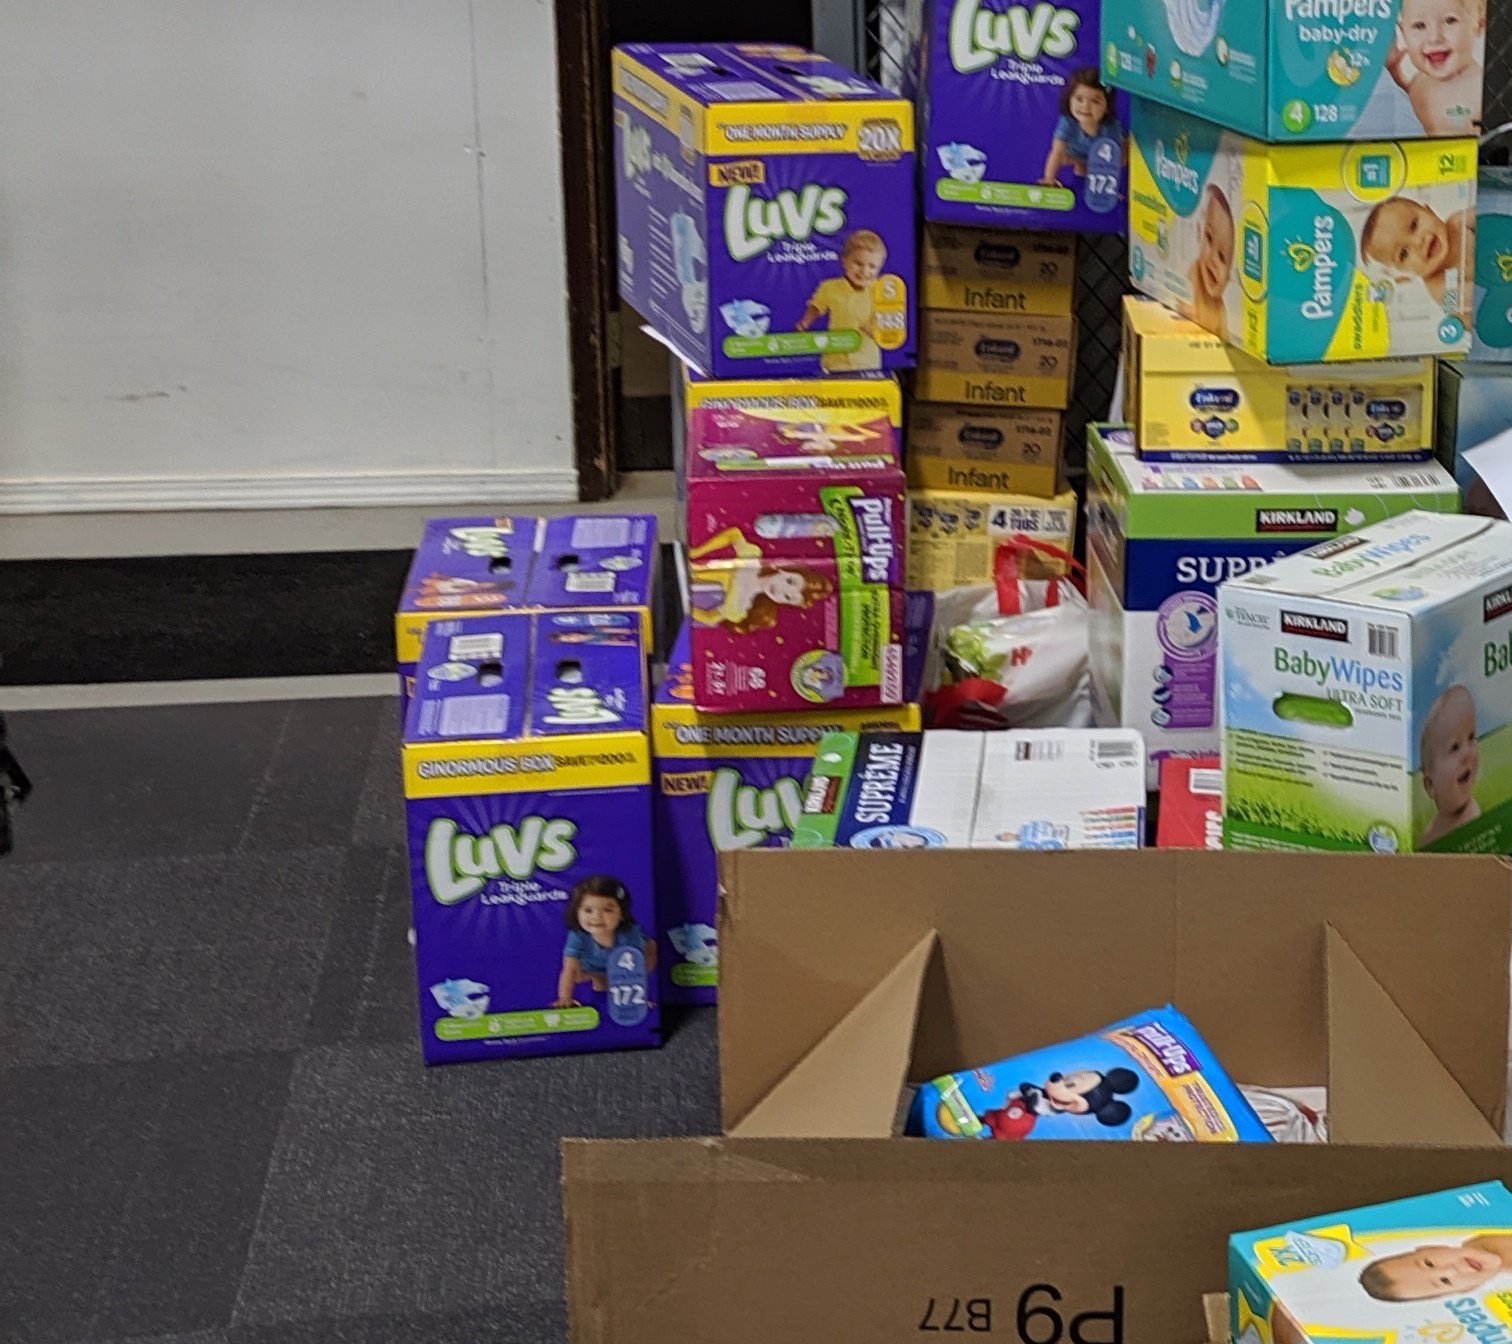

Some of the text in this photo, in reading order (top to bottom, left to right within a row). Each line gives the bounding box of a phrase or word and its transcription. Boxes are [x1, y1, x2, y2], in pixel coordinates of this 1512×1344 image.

[1298, 24, 1378, 44] baby-dry
[1289, 105, 1338, 123] 4 128
[1155, 141, 1199, 195] Pampers
[1089, 173, 1118, 194] 172
[725, 183, 848, 262] Luvs
[1301, 215, 1335, 320] Pampers
[964, 286, 1027, 310] Infant
[965, 380, 1027, 403] Infant
[948, 466, 1010, 489] Infant
[1259, 511, 1337, 524] KIRKLAND
[849, 497, 890, 582] Pull-Ups
[1283, 613, 1347, 634] KIRKLAND
[1274, 646, 1404, 692] BabyWipes
[1369, 696, 1403, 712] SOFT
[675, 725, 773, 744] ONE MONTH
[519, 753, 555, 771] BOX
[426, 816, 578, 904] Luvs
[618, 952, 634, 970] 4
[610, 985, 646, 1007] 172
[1271, 1242, 1300, 1269] 2X
[918, 1295, 992, 1332] B77
